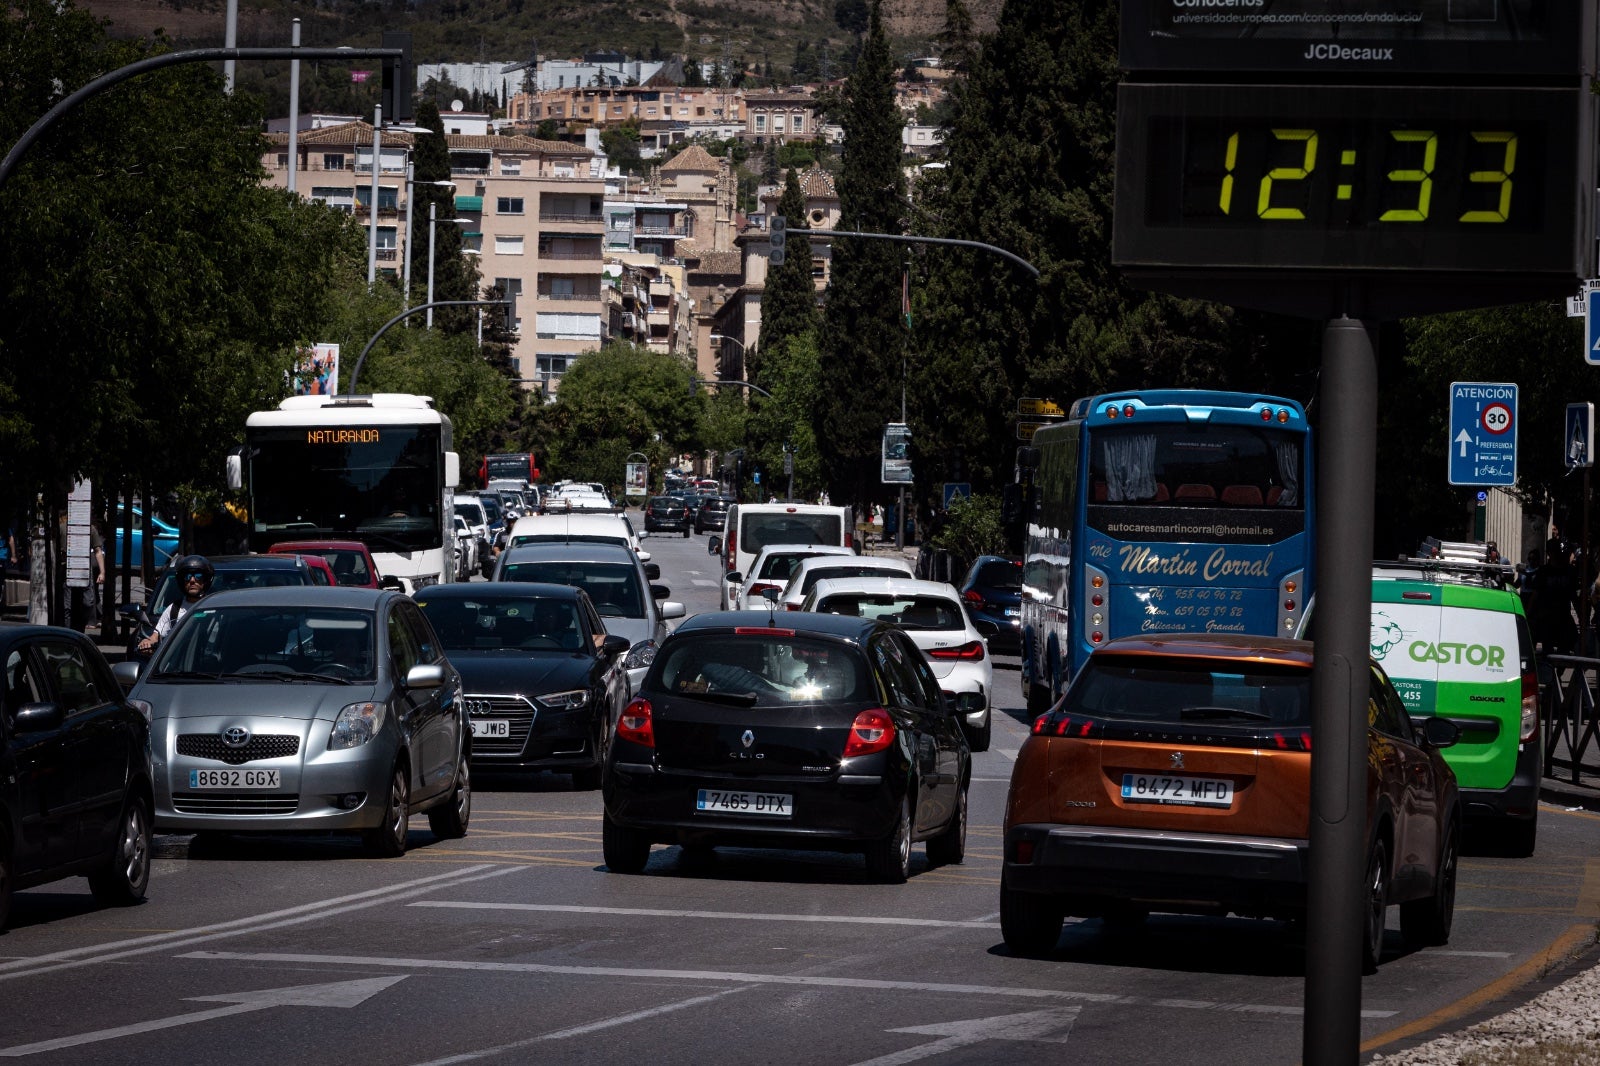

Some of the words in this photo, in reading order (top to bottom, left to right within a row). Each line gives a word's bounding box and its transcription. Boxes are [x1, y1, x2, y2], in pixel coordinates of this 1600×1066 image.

[1304, 44, 1393, 60] JCDecaux
[1219, 129, 1518, 222] 12:33
[1455, 386, 1513, 399] ATENCIÓN
[1488, 413, 1507, 424] 30
[308, 429, 379, 443] NATURANDA
[1107, 522, 1274, 536] autocaresmartincorral@hotmail.es
[1203, 547, 1274, 581] Corral
[1175, 606, 1195, 616] 659
[1197, 606, 1211, 617] 05
[1141, 619, 1186, 632] Calicasas
[1205, 619, 1246, 633] Granada
[1408, 640, 1505, 668] CASTOR
[1403, 691, 1421, 700] 455
[481, 722, 507, 735] JWB
[729, 751, 766, 760] CLIO
[199, 771, 240, 786] 8692
[245, 771, 277, 786] GGX
[1136, 777, 1183, 797] 8472
[1190, 782, 1228, 801] MFD
[711, 792, 750, 810] 7465
[755, 795, 786, 812] DTX
